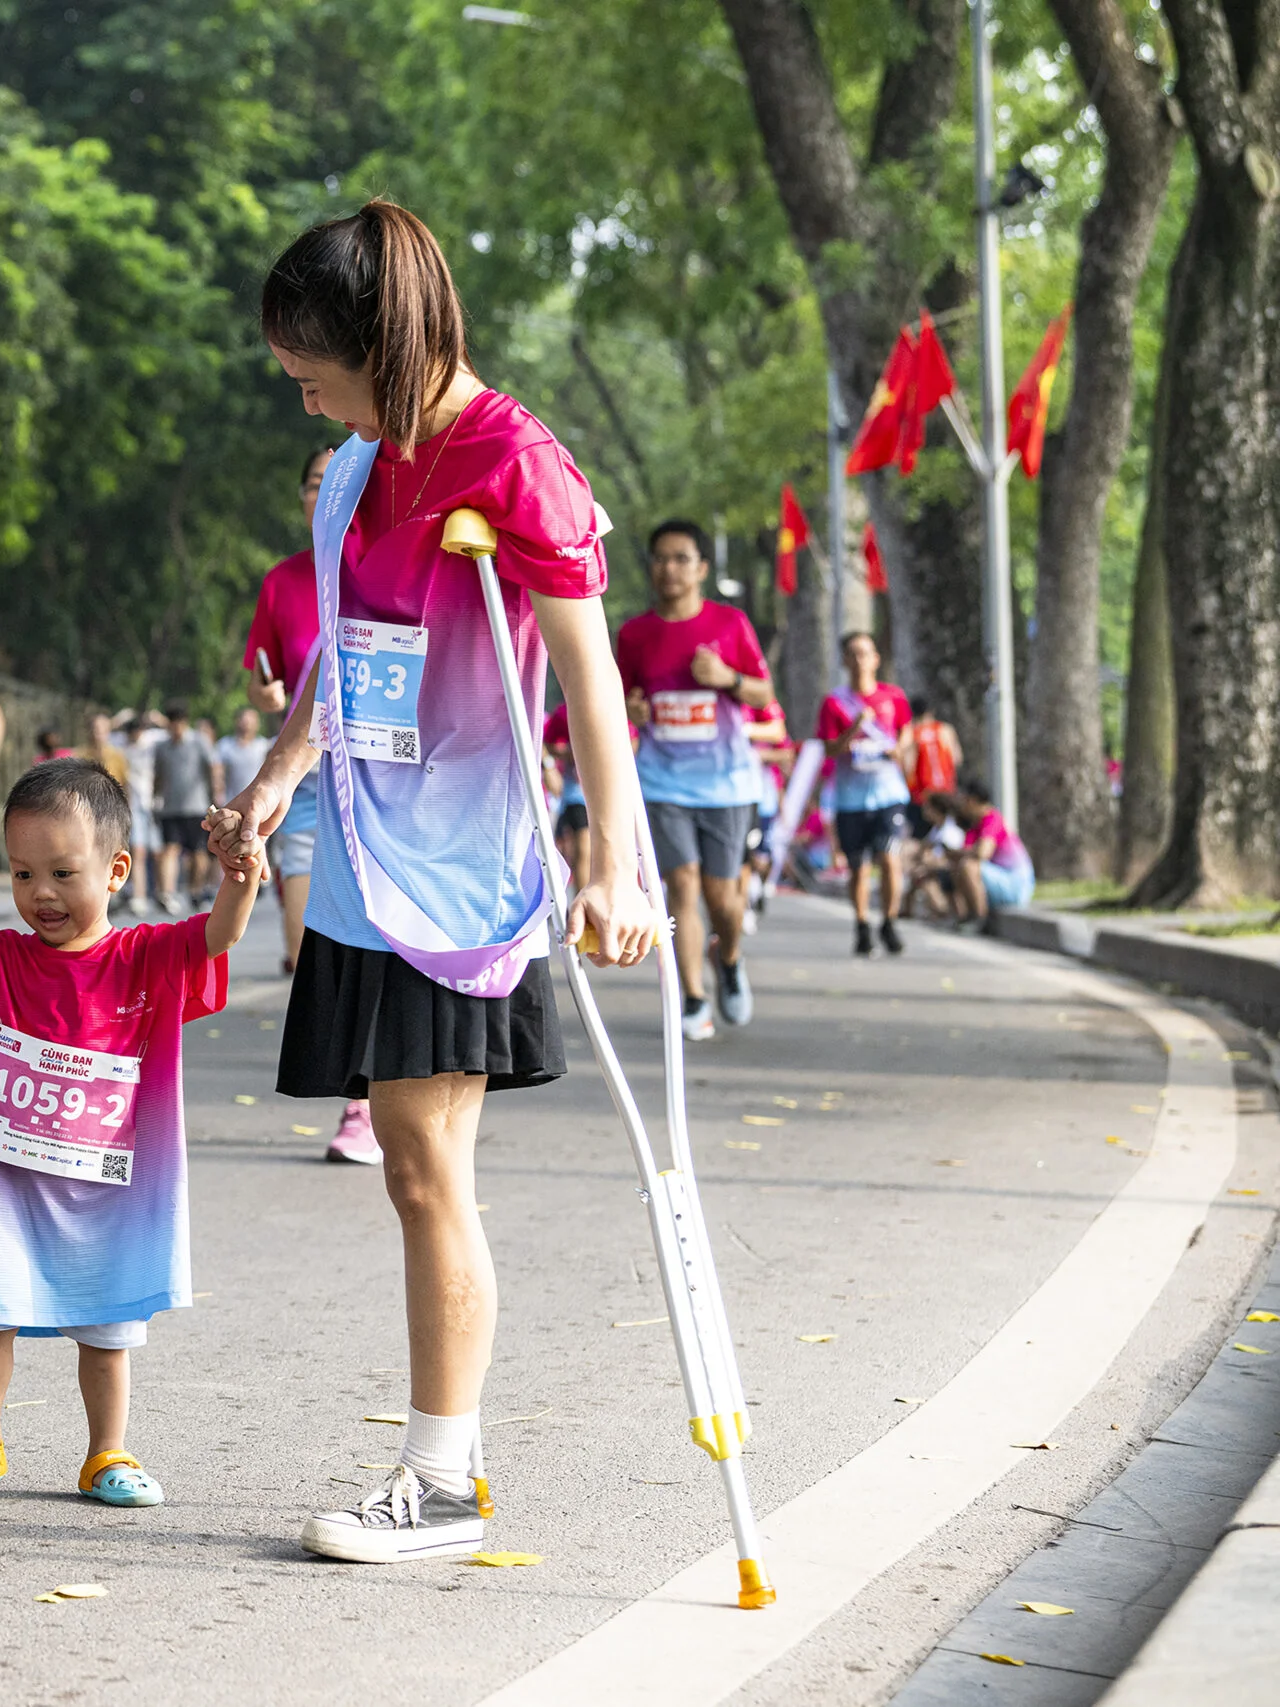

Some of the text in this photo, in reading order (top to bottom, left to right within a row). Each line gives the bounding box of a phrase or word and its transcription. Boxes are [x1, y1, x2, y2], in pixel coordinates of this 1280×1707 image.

[338, 656, 407, 700] 59-3
[329, 690, 349, 812] EKIDEN
[341, 815, 362, 892] 202
[423, 957, 504, 993] APPY
[39, 1061, 90, 1077] HẠNH PHÚC
[41, 1047, 70, 1062] CÙNG
[72, 1055, 93, 1067] BẠN
